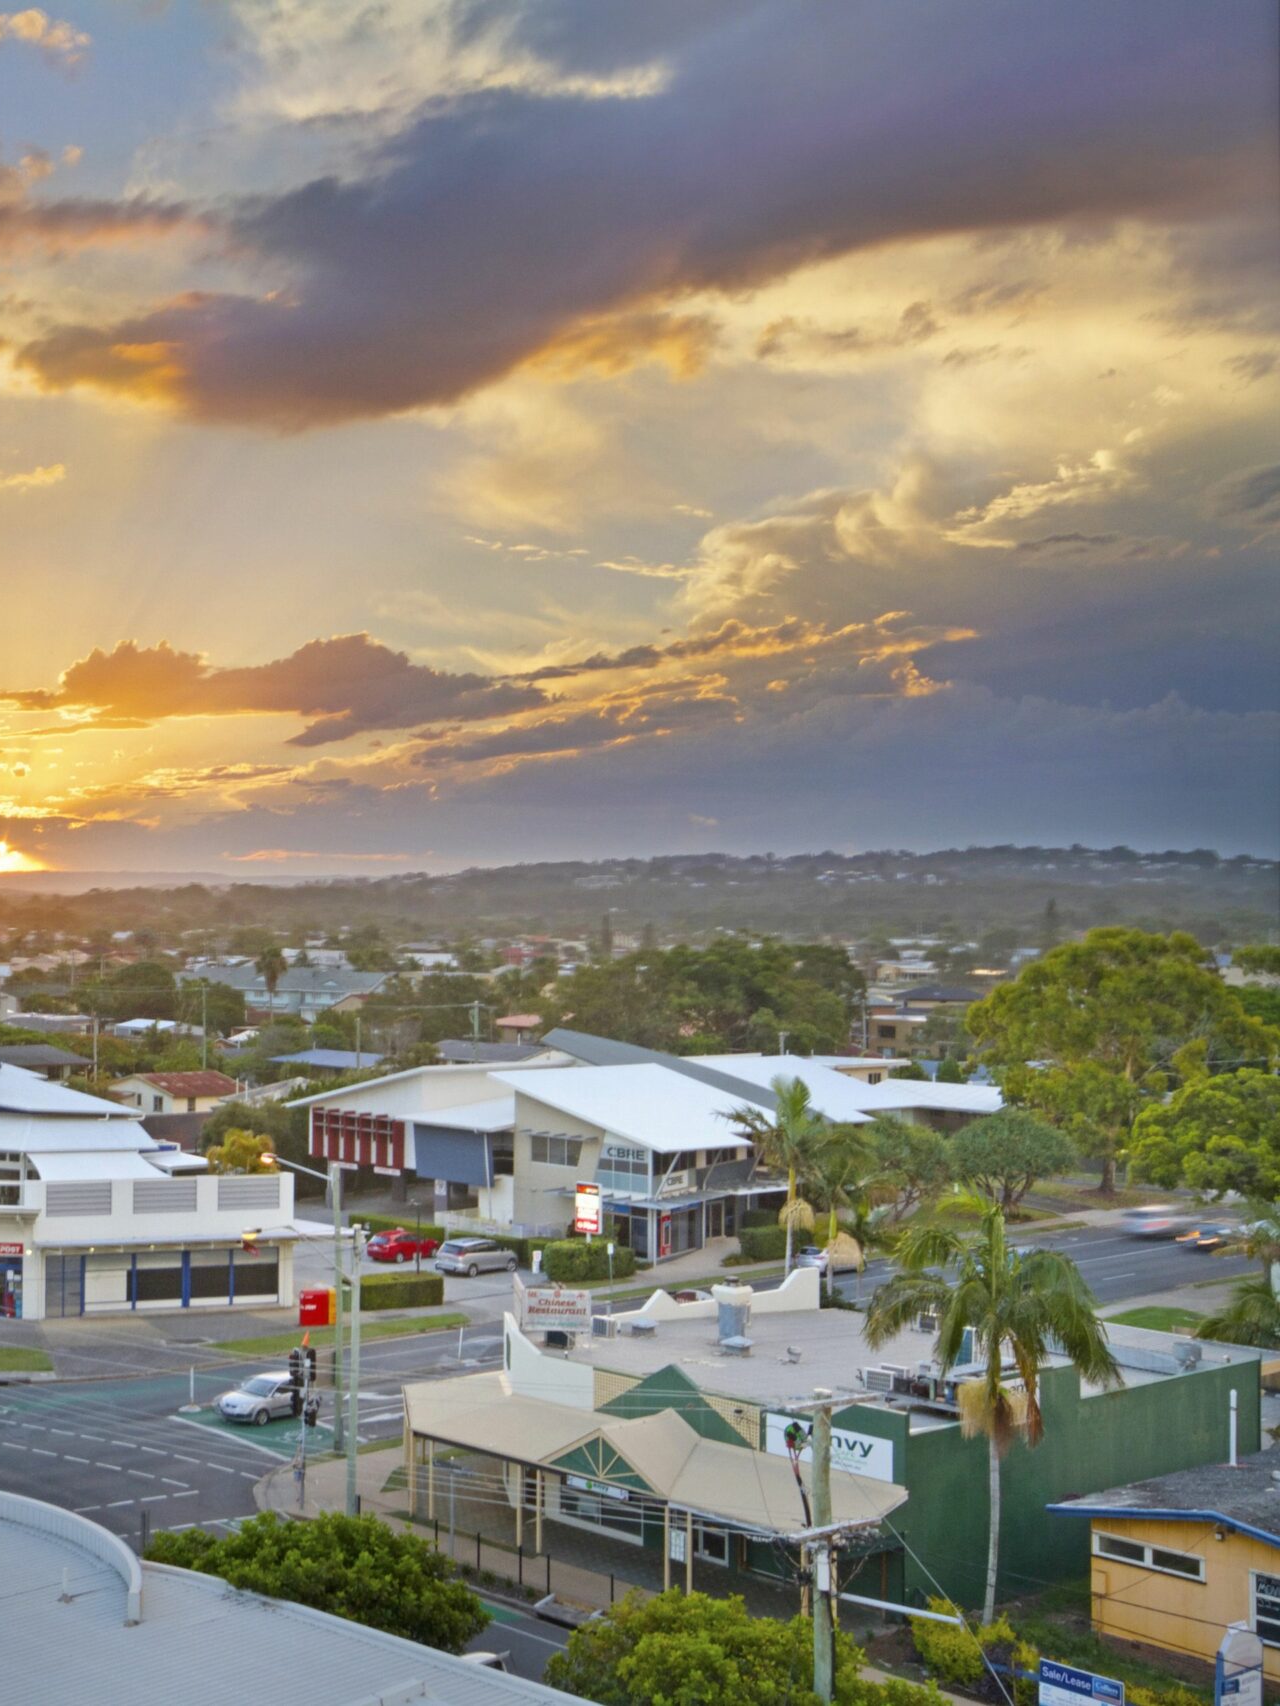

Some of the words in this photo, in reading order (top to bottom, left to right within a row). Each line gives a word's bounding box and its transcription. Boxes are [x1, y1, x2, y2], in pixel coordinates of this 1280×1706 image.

[607, 1146, 645, 1161] CBRE
[0, 1245, 21, 1253] POST
[538, 1298, 577, 1307] Chinese
[527, 1305, 587, 1316] Restaurant
[830, 1434, 874, 1458] nvy
[1042, 1665, 1092, 1691] Sale/Lease
